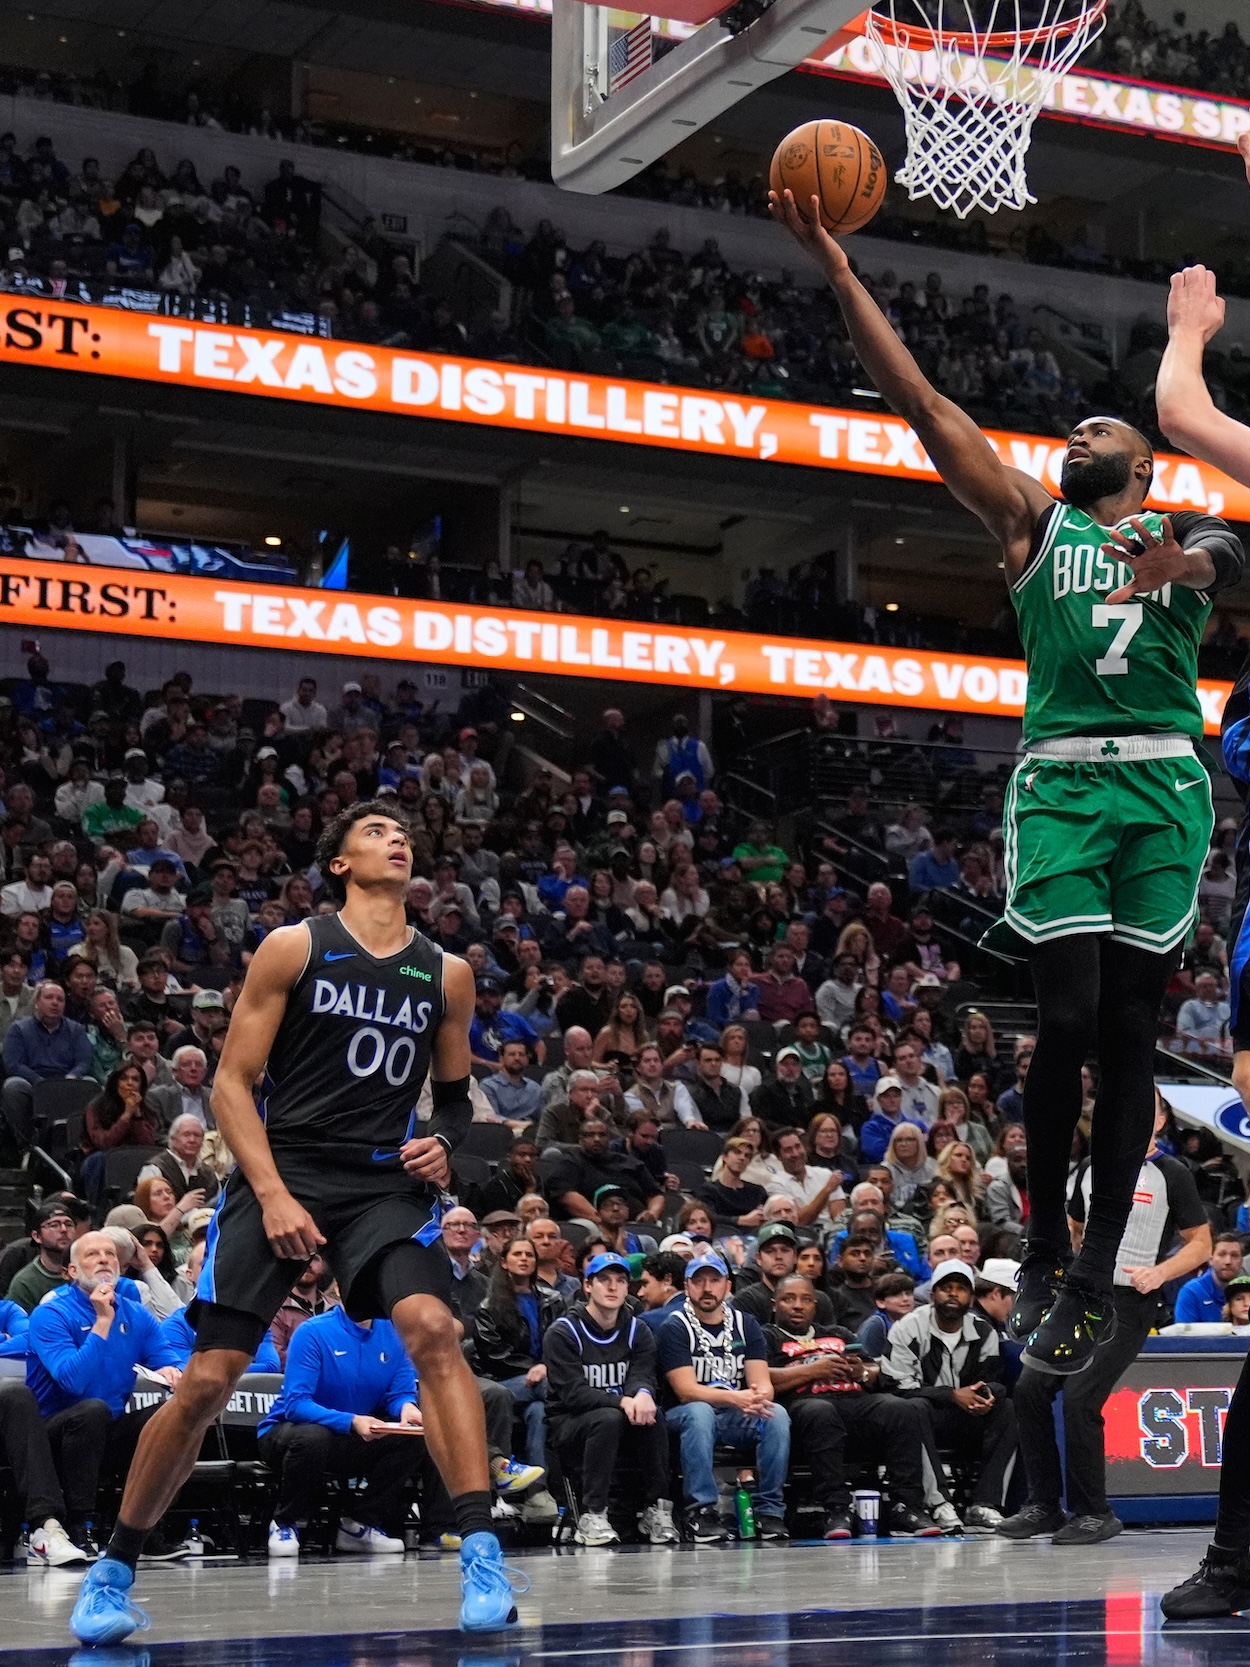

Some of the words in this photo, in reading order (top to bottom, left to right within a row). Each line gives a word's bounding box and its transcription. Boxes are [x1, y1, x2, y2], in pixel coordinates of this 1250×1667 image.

[1032, 71, 1184, 131] TEXAS
[148, 322, 378, 412] TEXAS
[391, 356, 779, 460] DISTILLERY,
[0, 573, 176, 622] FIRST:
[214, 591, 403, 647] TEXAS
[413, 608, 736, 685] DISTILLERY,
[761, 646, 923, 696] TEXAS
[930, 661, 1027, 704] VOD
[1092, 603, 1143, 676] 7
[399, 964, 432, 983] chime
[310, 978, 433, 1034] DALLAS
[347, 1026, 416, 1087] 00
[226, 1391, 252, 1413] GET
